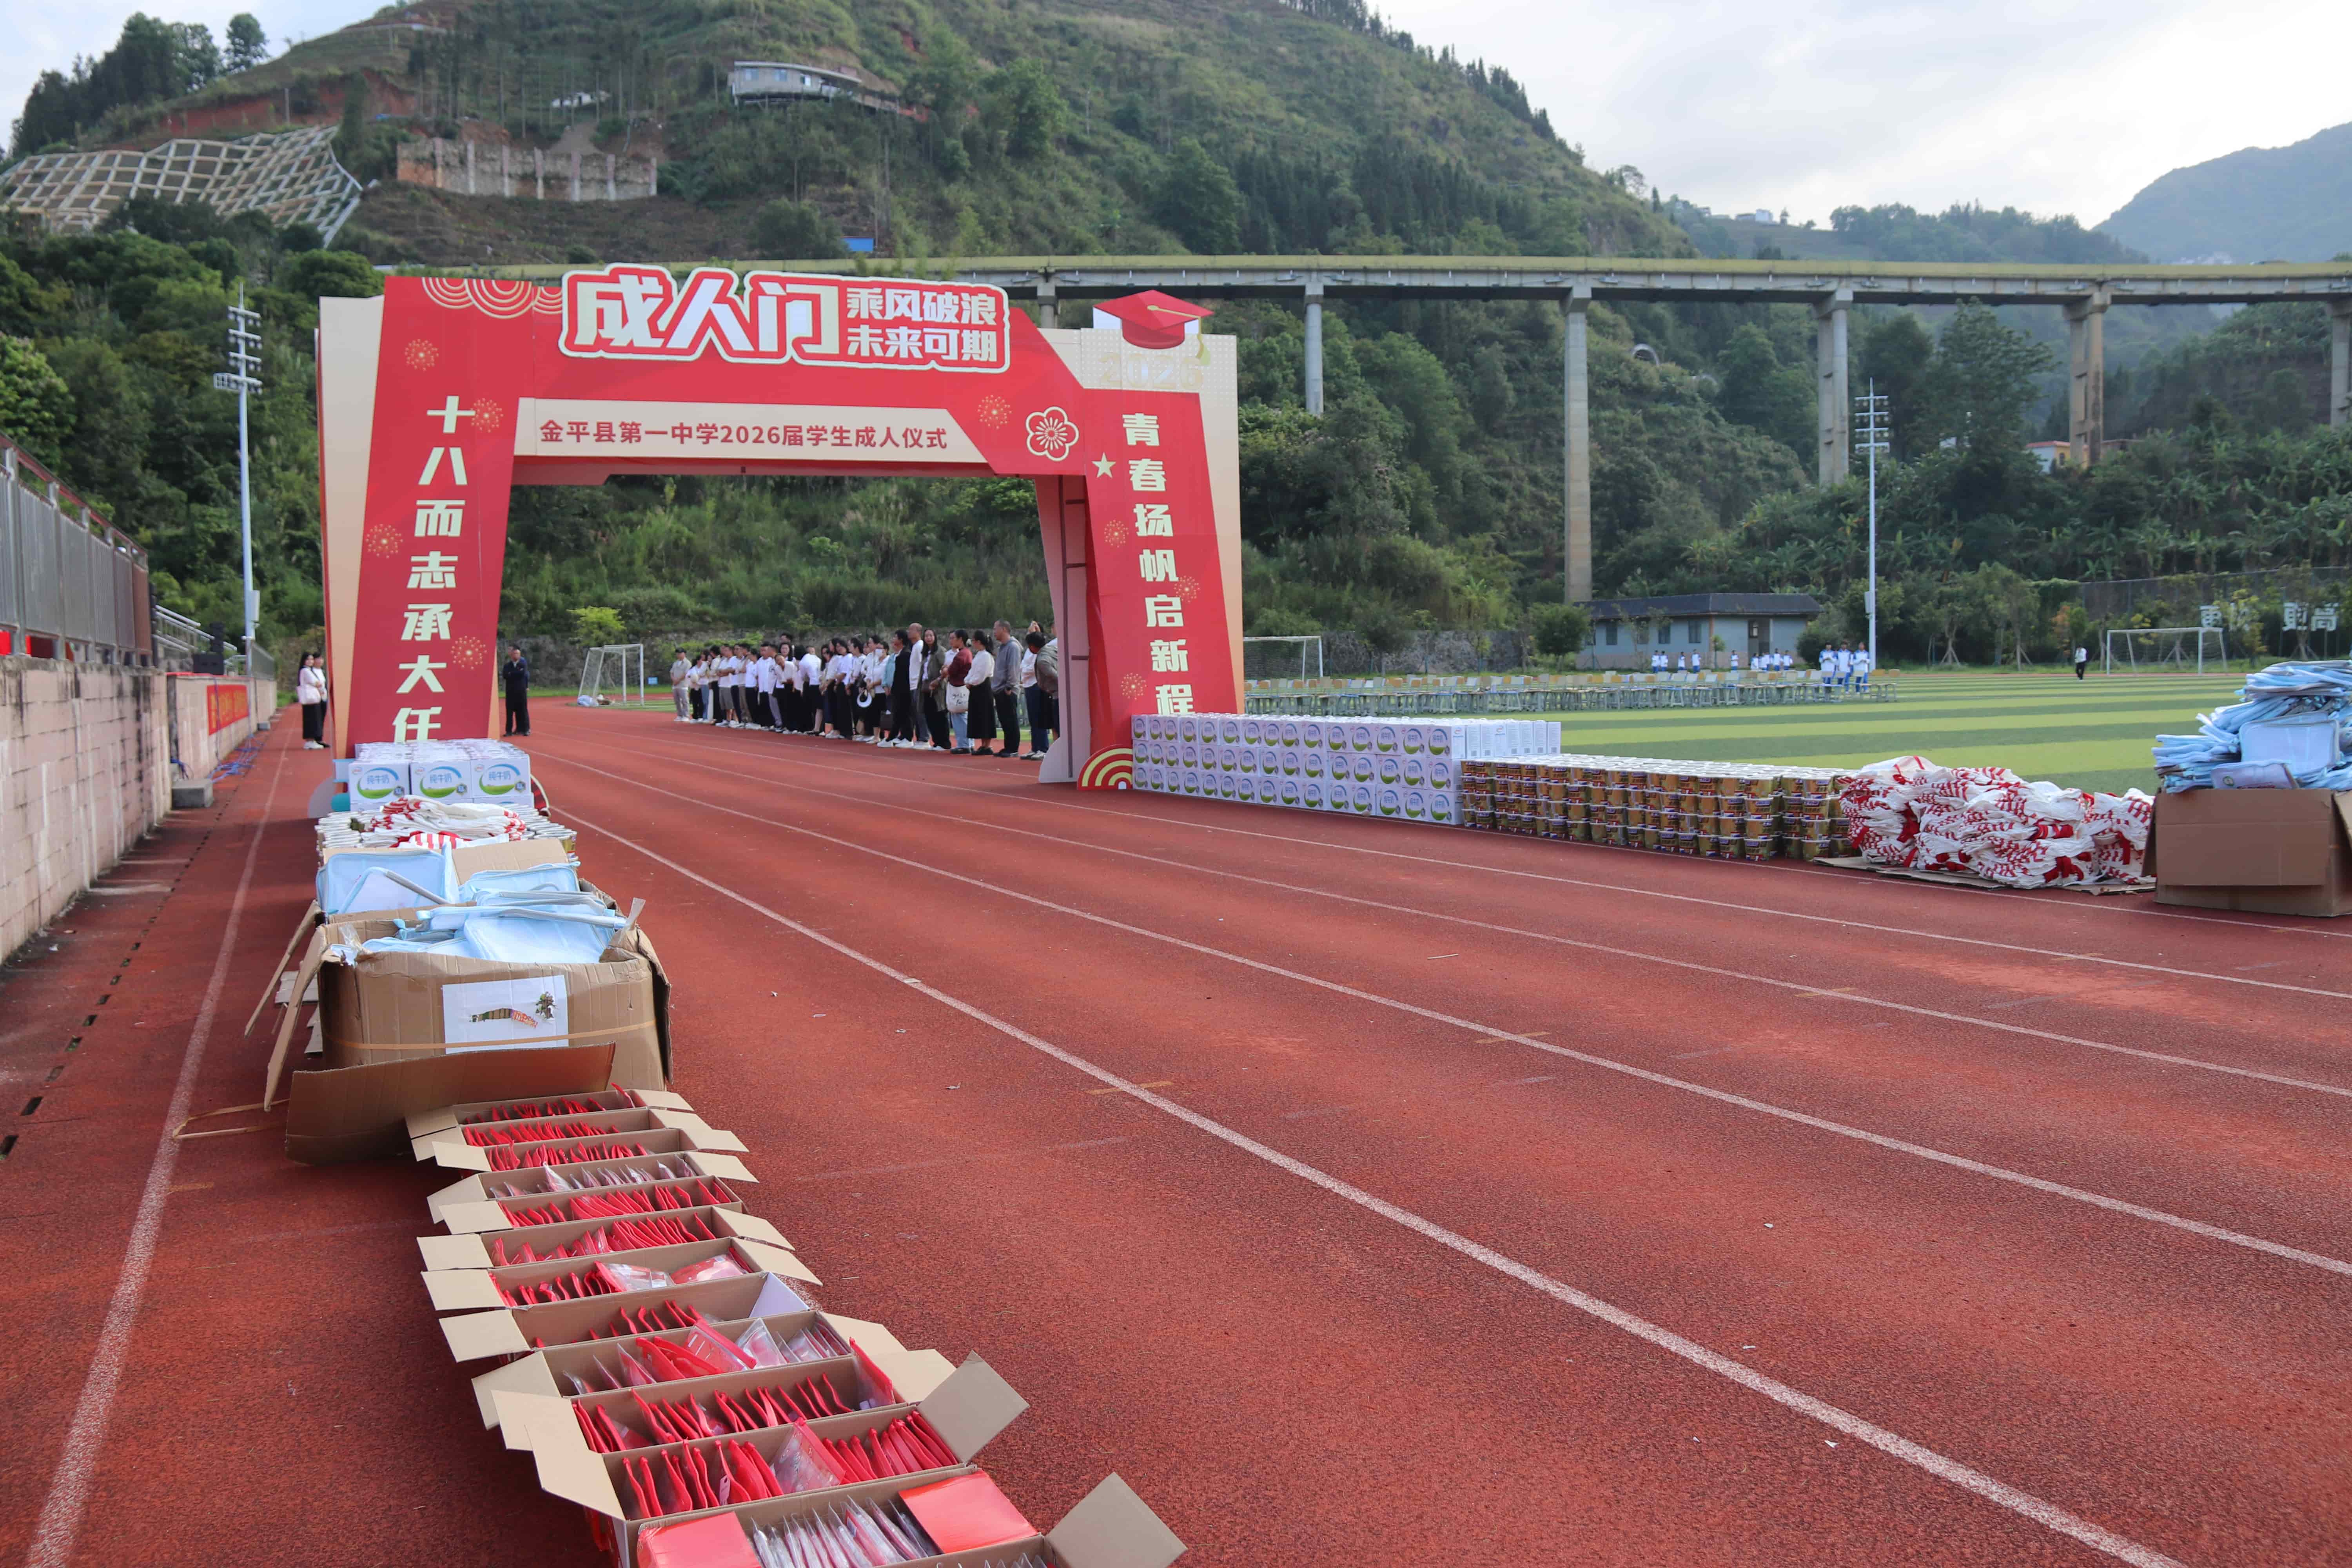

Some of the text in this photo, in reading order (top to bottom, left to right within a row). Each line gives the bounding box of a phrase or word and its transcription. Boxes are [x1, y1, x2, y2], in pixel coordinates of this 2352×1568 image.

[575, 275, 840, 354] 成人门
[846, 288, 996, 325] 乘风破浪
[847, 326, 997, 361] 未来可期
[1098, 352, 1204, 389] 2026
[540, 420, 947, 449] 金平县第一中学2026届学生成人仪式
[392, 395, 475, 743] 十八而志承大任
[1122, 413, 1194, 715] 青春扬帆启新程
